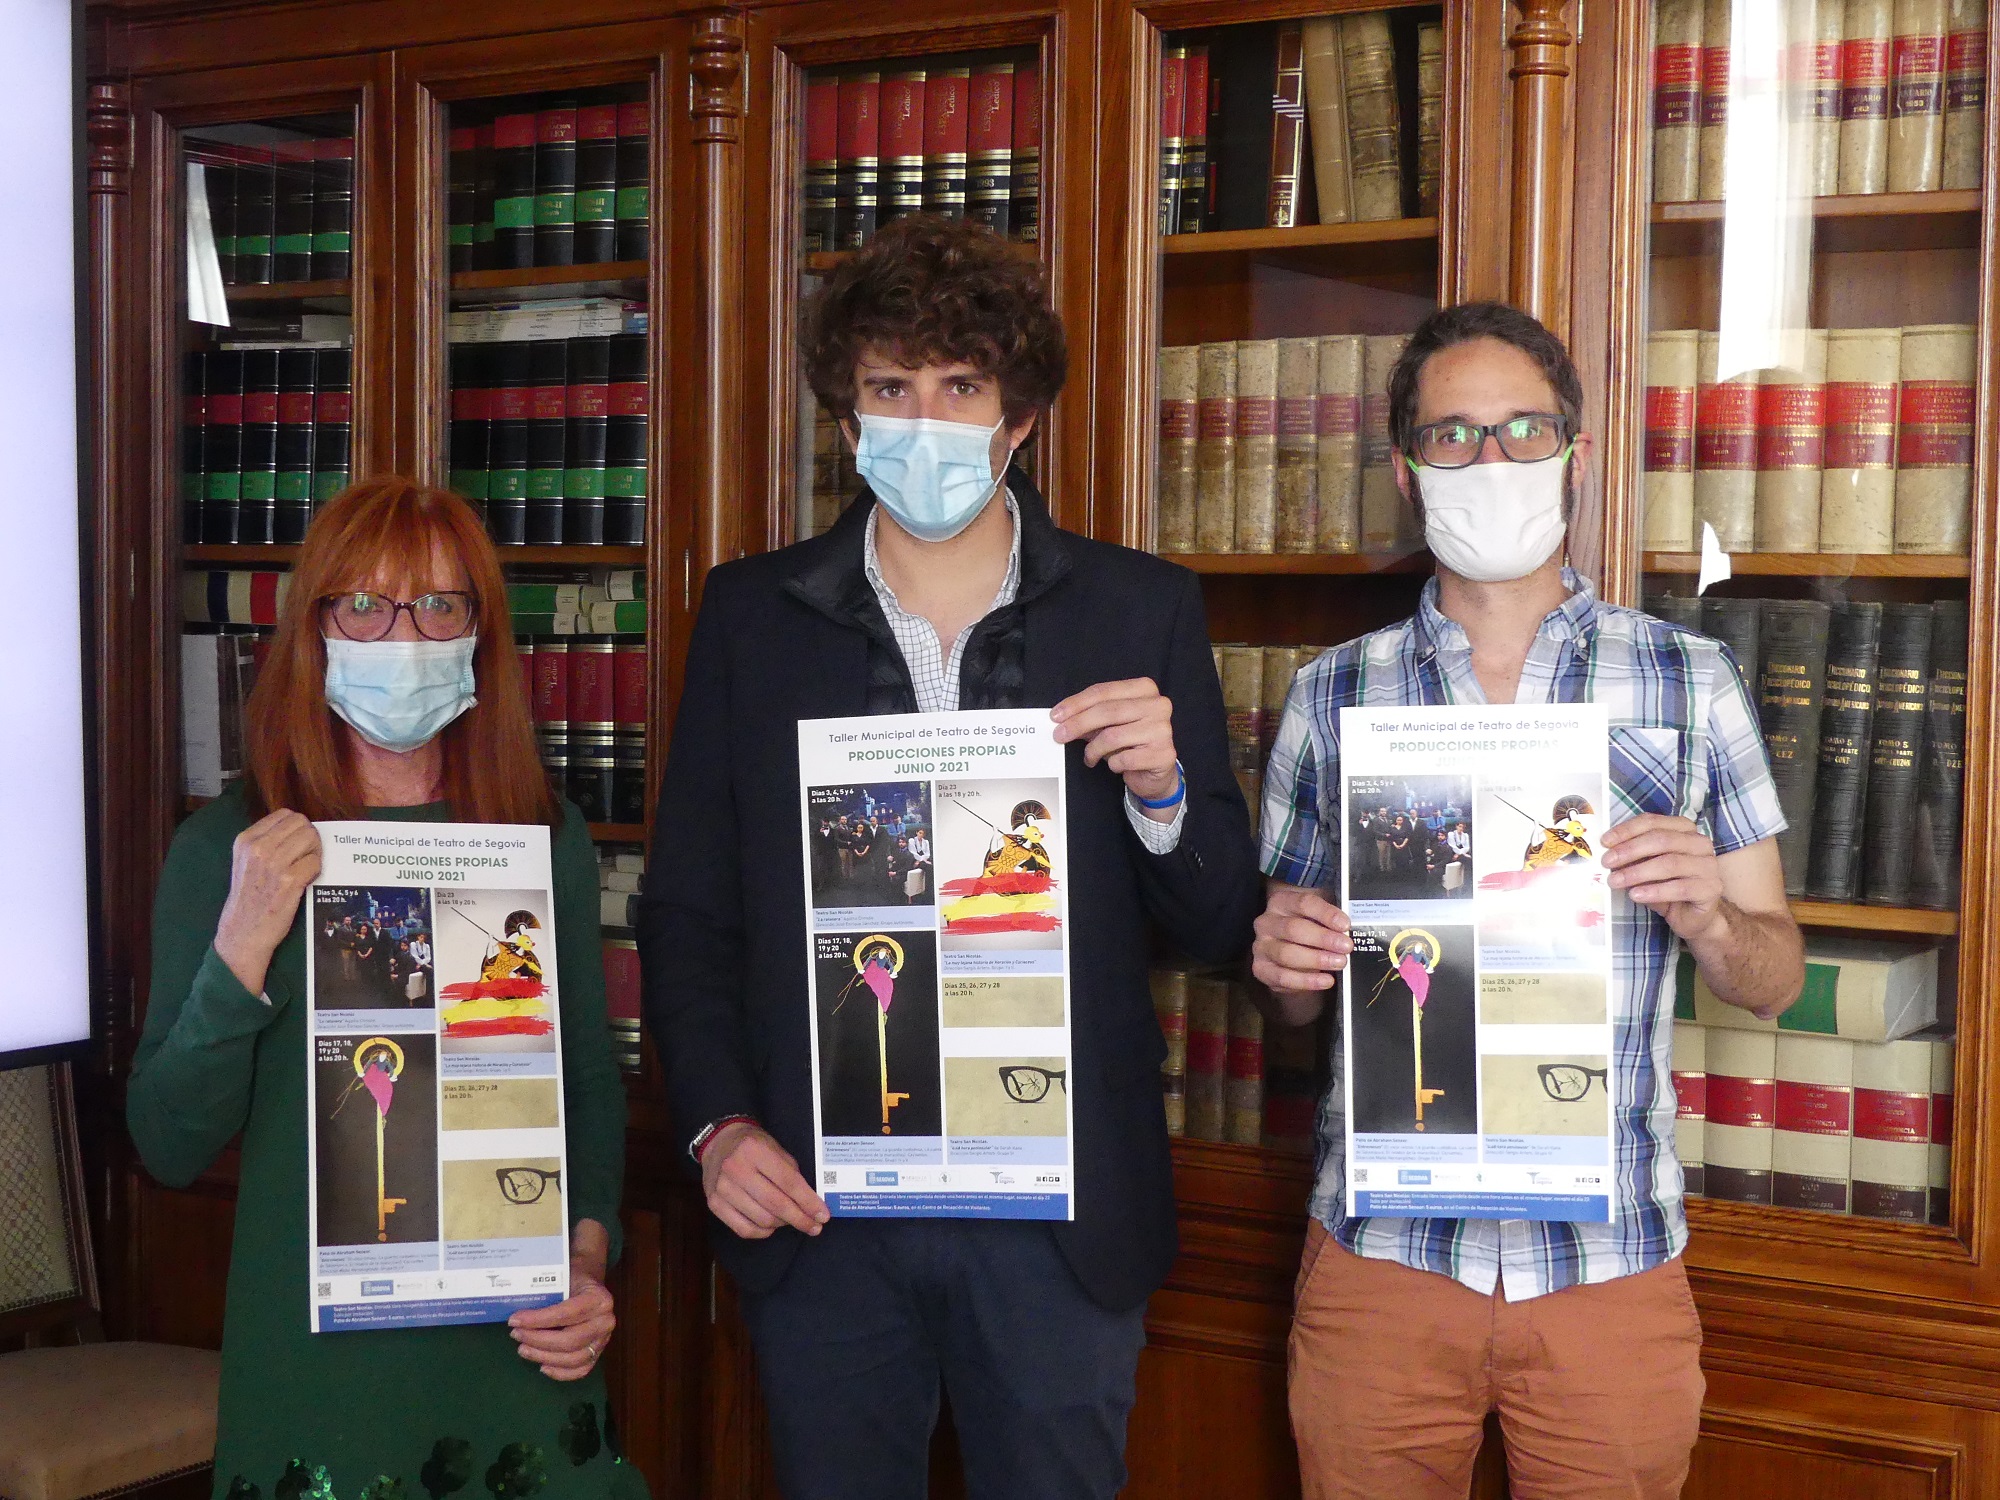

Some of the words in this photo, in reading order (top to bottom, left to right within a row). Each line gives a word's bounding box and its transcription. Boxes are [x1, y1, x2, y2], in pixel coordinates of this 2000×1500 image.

[1370, 722, 1399, 731] Taller
[1403, 722, 1456, 732] Municipal
[1460, 722, 1474, 730] de
[1478, 721, 1512, 730] Teatro
[1516, 720, 1530, 729] de
[1534, 720, 1579, 731] Segovia
[829, 734, 858, 743] Taller
[862, 730, 915, 741] Municipal
[918, 729, 932, 737] de
[936, 727, 970, 736] Teatro
[974, 726, 987, 735] de
[991, 725, 1035, 736] Segovia
[1390, 740, 1497, 752] PRODUCCIONES
[1501, 739, 1559, 750] PROPIAS
[1878, 739, 1900, 747] TOMO
[849, 746, 955, 761] PRODUCCIONES
[960, 745, 1016, 757] PROPIAS
[894, 762, 935, 774] JUNIO
[940, 761, 969, 772] 2021
[334, 835, 361, 844] Taller
[365, 836, 414, 847] Municipal
[418, 838, 431, 846] de
[434, 838, 465, 847] Teatro
[469, 839, 482, 847] de
[485, 839, 526, 849] Segovia
[353, 854, 452, 866] PRODUCCIONES
[456, 857, 508, 867] PROPIAS
[396, 870, 433, 880] JUNIO
[438, 871, 465, 881] 2021
